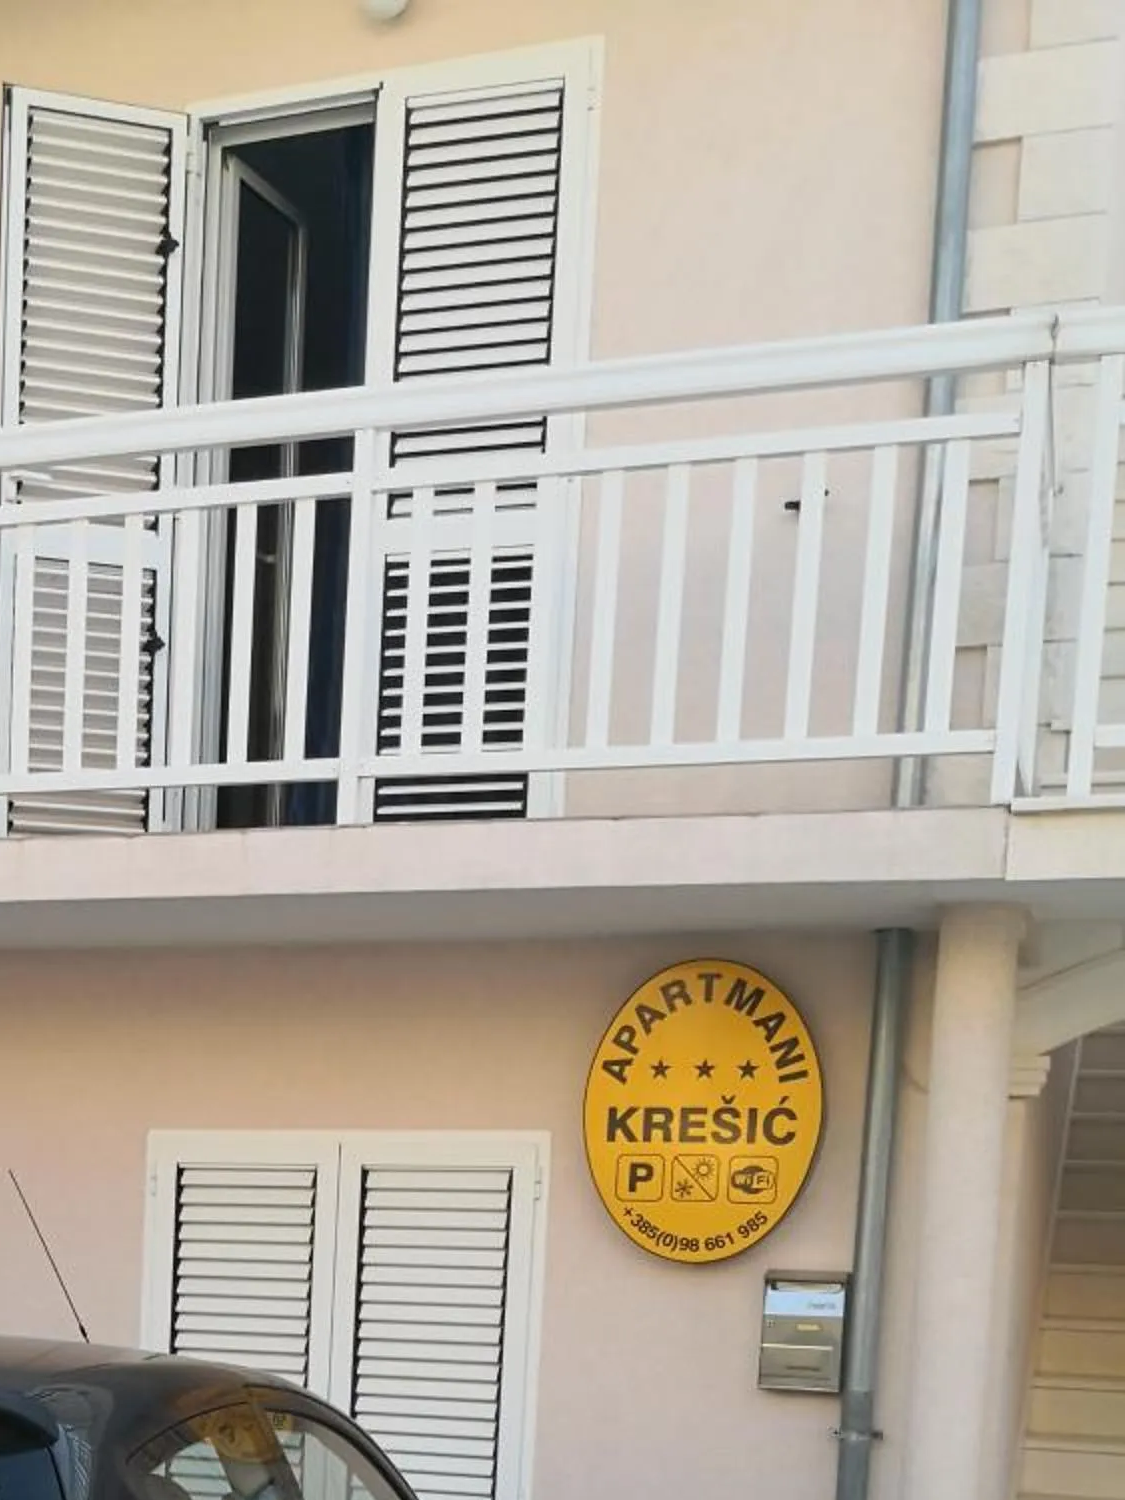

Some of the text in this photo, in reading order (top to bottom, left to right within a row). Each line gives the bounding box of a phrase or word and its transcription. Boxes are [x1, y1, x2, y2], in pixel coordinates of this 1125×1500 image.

[602, 972, 809, 1085] APARTMANI
[606, 1095, 798, 1146] KREŠIĆ
[627, 1162, 655, 1194] P
[623, 1206, 768, 1252] +385(0)98 661 985
